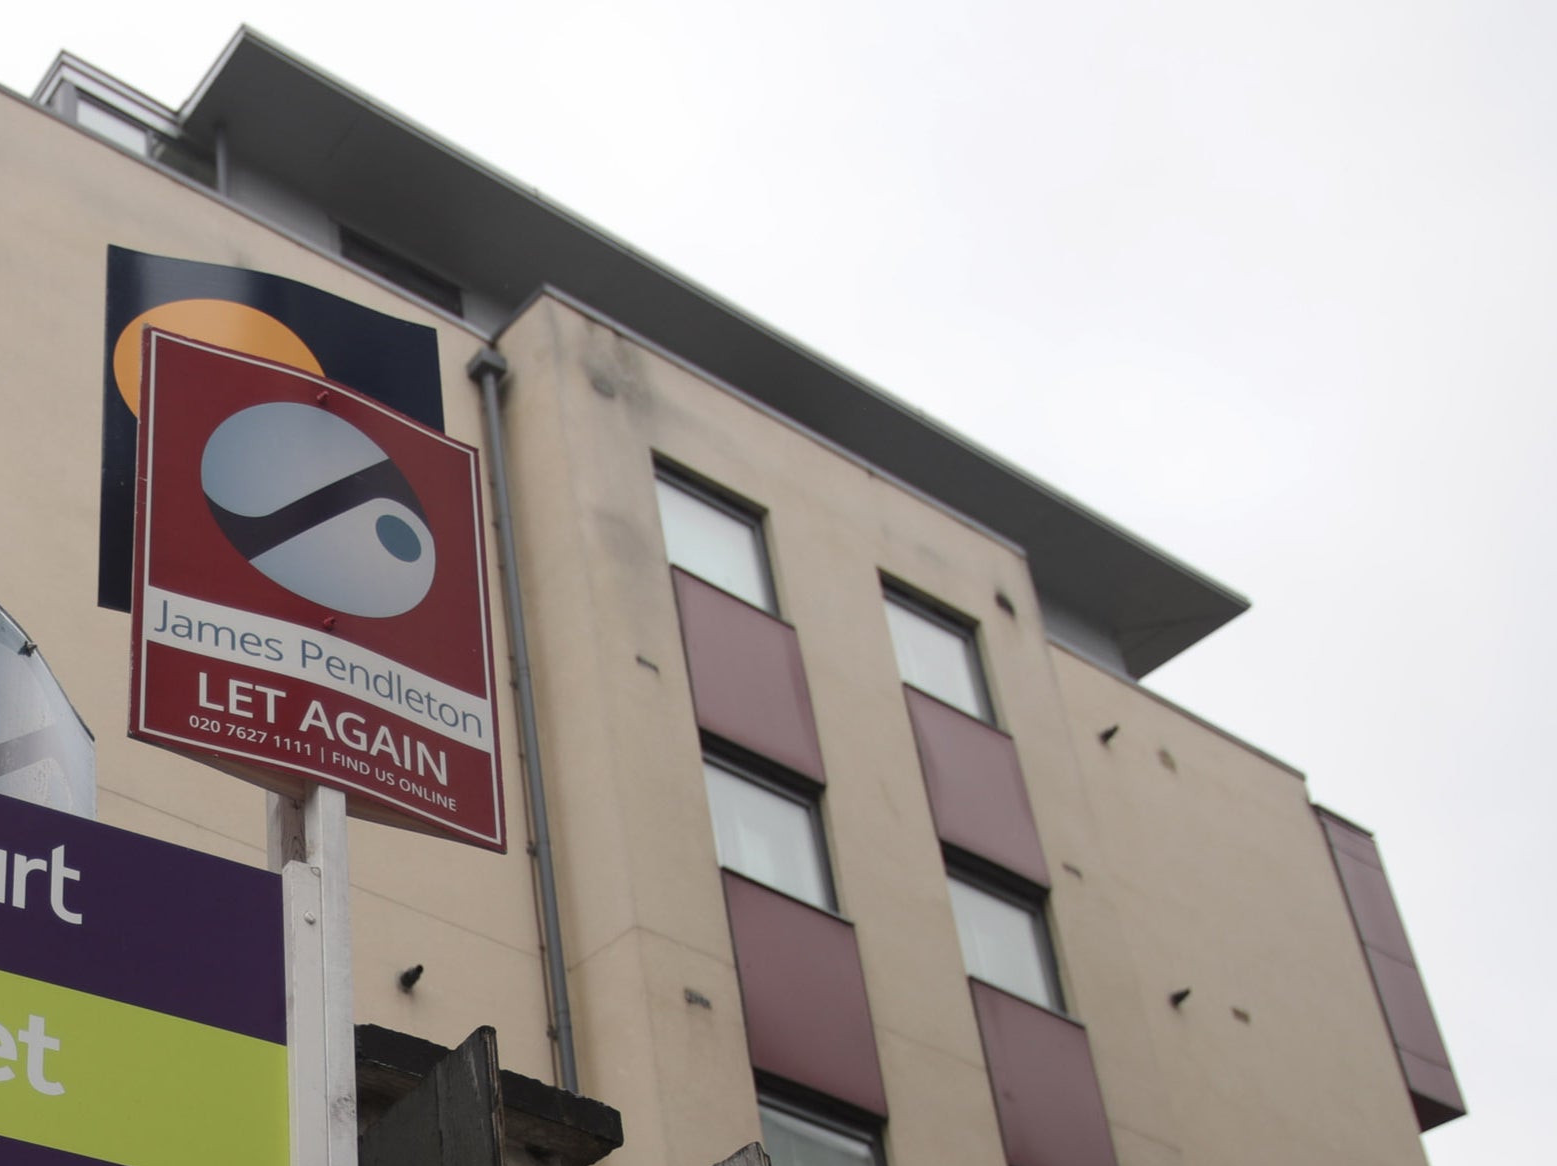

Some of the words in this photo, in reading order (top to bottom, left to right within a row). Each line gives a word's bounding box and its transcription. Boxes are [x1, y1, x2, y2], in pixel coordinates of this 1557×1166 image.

[154, 599, 283, 663] James
[301, 639, 484, 738] Pendleton
[189, 715, 220, 732] 020
[227, 722, 267, 743] 7627
[273, 735, 312, 756] 1111
[332, 752, 370, 775] FIND
[375, 766, 395, 785] US
[399, 776, 457, 812] ONLINE
[198, 671, 287, 724] LET
[299, 700, 448, 787] AGAIN
